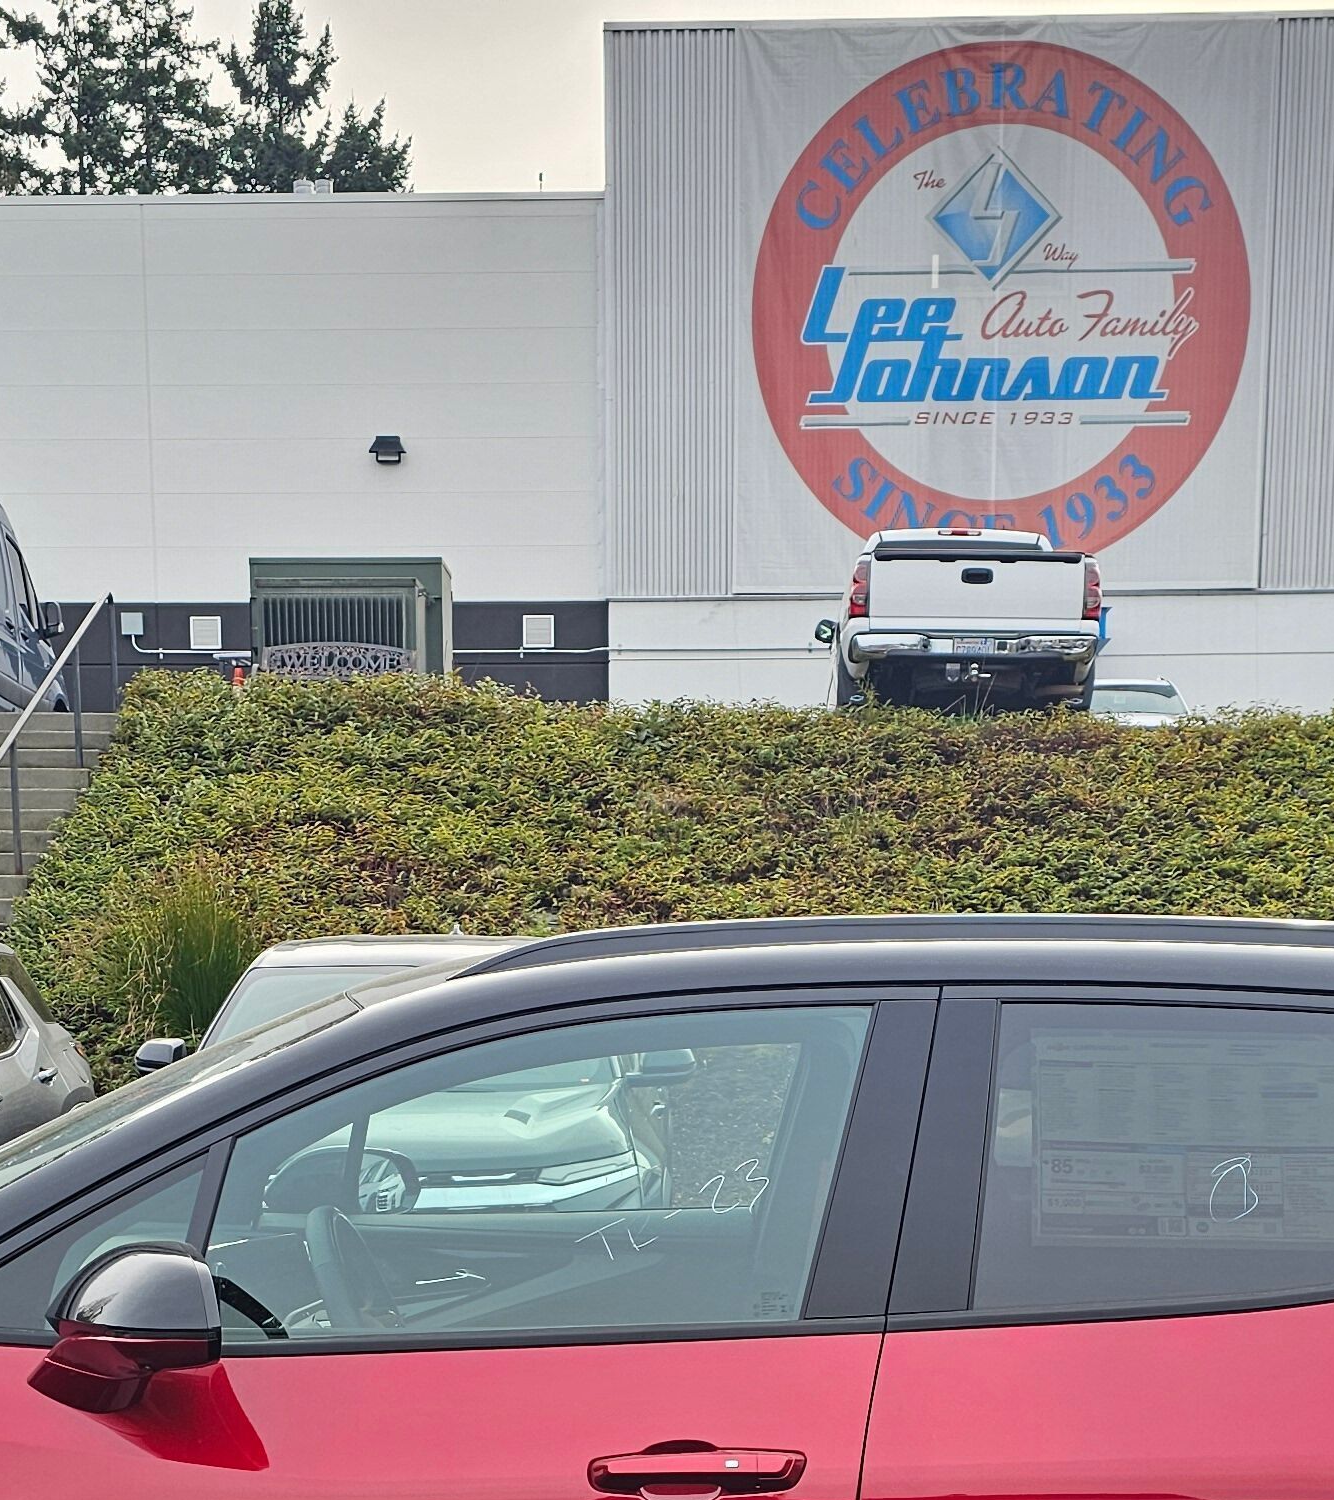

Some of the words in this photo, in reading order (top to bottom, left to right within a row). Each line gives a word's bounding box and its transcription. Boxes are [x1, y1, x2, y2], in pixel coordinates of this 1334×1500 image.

[796, 62, 1214, 230] CELEBRATING
[913, 169, 947, 191] The
[1042, 243, 1079, 269] Way
[802, 266, 963, 343] Lee
[980, 289, 1069, 341] Auto
[1075, 287, 1199, 358] Family
[807, 326, 1167, 404] Johnson
[913, 411, 995, 425] SINCE
[1009, 411, 1075, 425] 1933
[1038, 452, 1157, 550] 1933
[281, 653, 400, 671] WELCOME
[1050, 1158, 1074, 1174] 85
